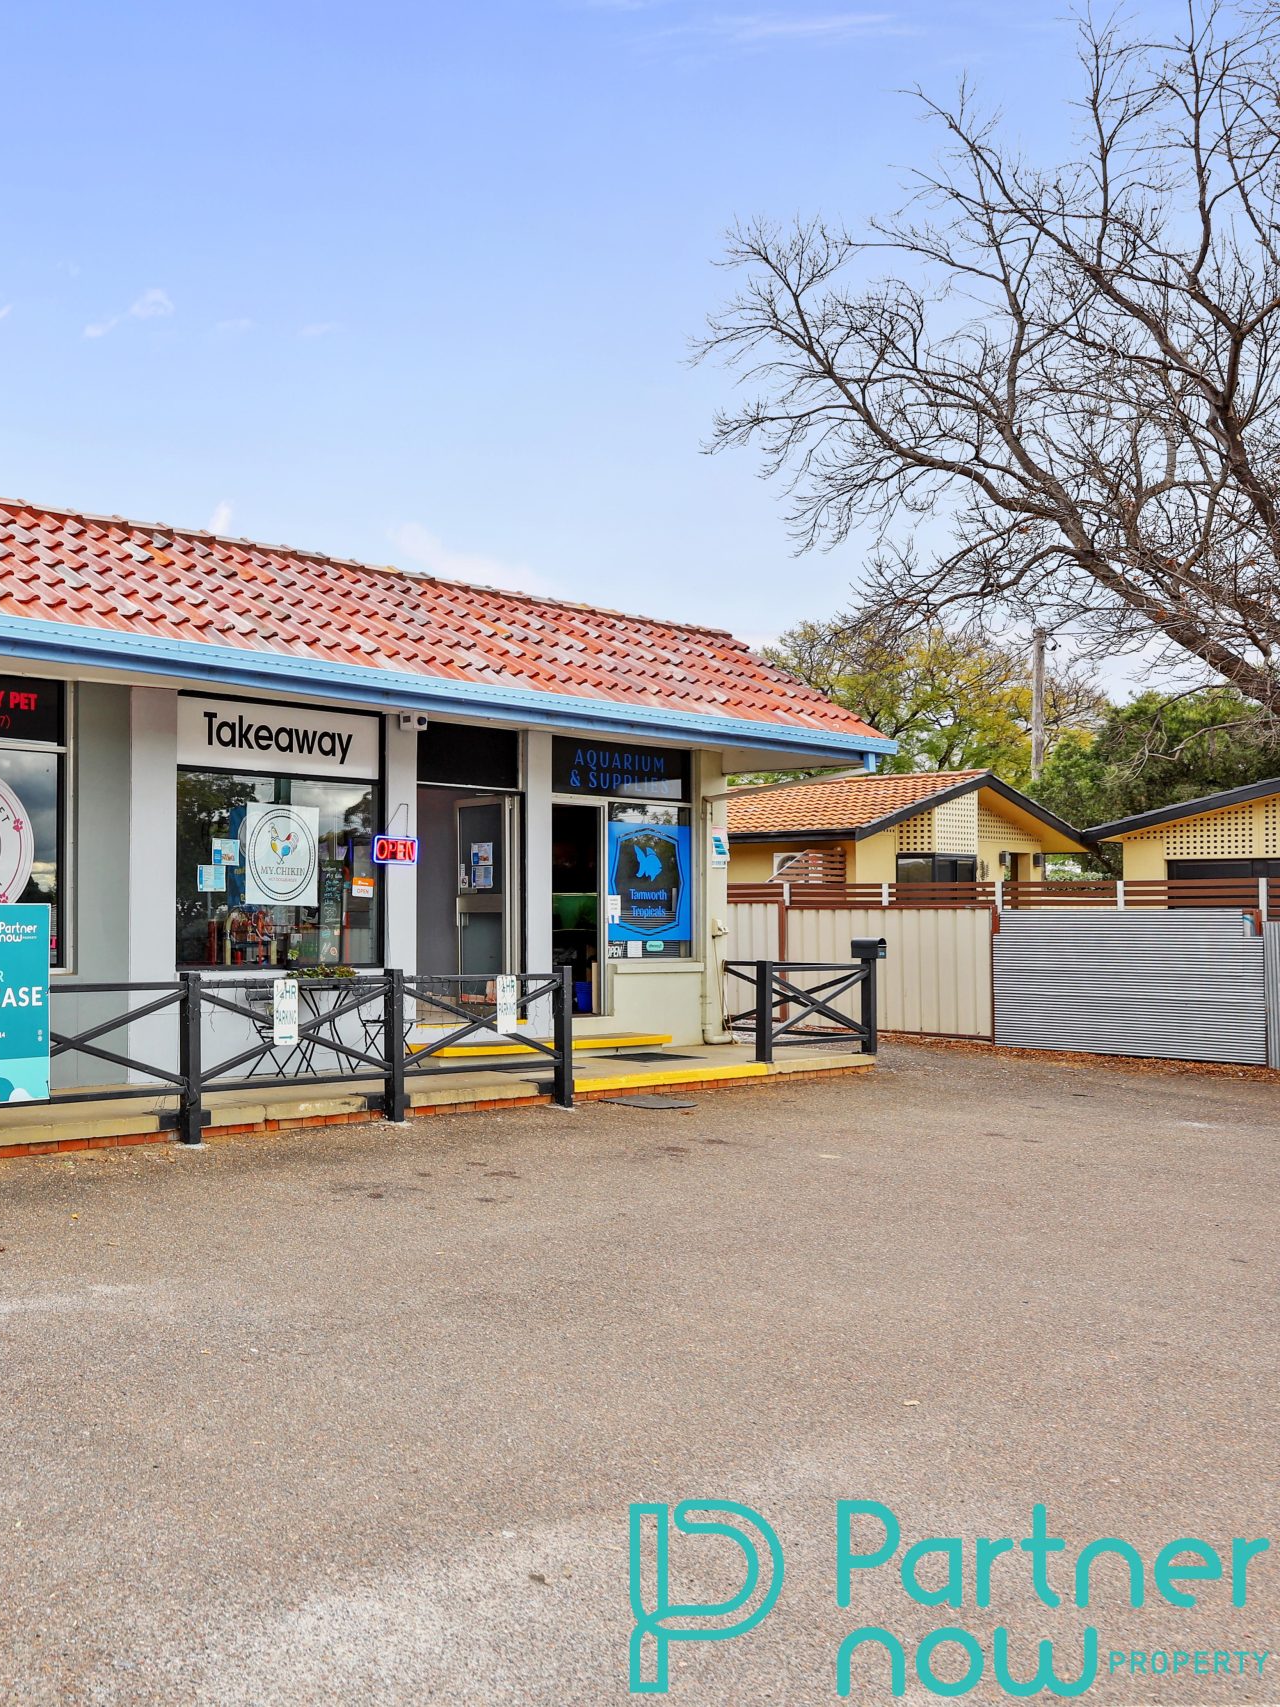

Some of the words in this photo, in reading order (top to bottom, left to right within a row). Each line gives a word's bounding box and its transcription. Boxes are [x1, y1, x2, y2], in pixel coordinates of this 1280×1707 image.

[10, 691, 38, 711] PET
[203, 711, 353, 764] Takeaway
[574, 749, 664, 773] AQUARIUM
[570, 769, 581, 788] &
[588, 771, 669, 794] SUPPLIES
[376, 839, 416, 862] OPEN
[629, 888, 667, 900] Tamworth
[631, 906, 666, 918] Tropicals
[0, 921, 38, 933] Partner
[0, 934, 23, 942] now
